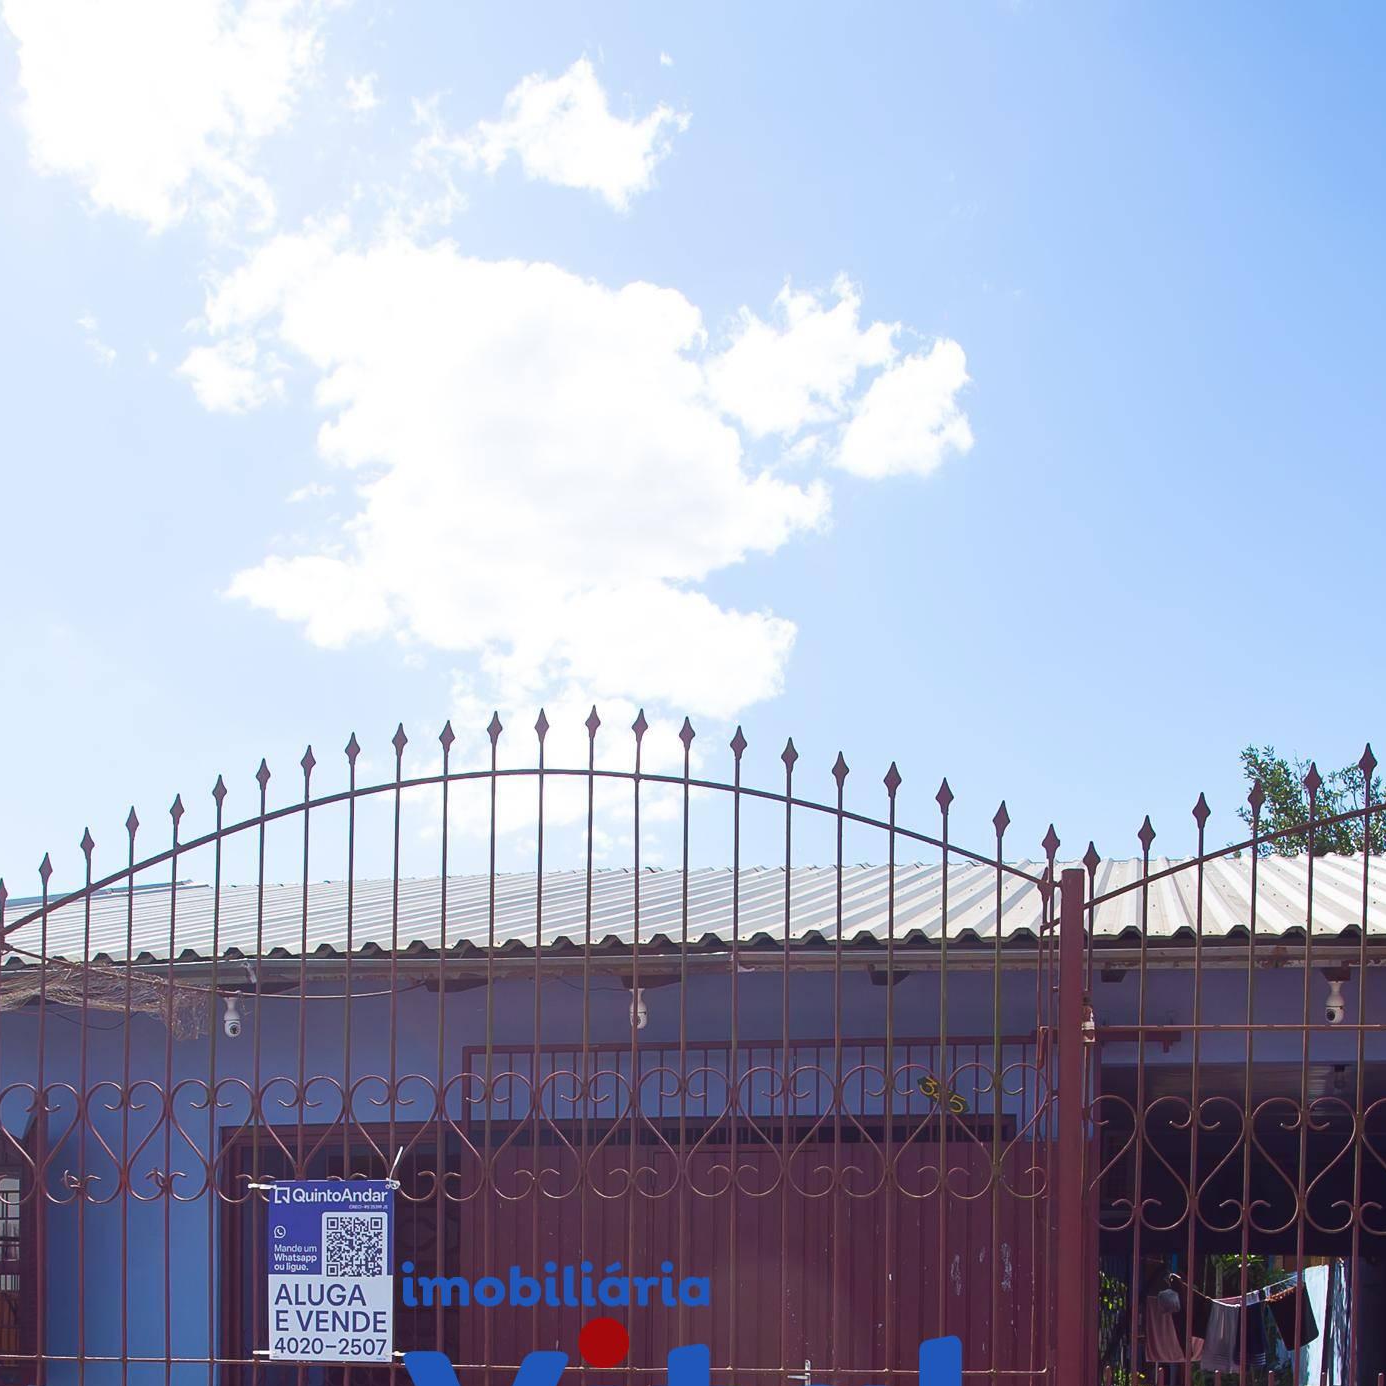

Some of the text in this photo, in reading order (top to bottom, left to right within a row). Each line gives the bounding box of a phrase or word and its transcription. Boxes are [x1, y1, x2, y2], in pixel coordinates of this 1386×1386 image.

[293, 1188, 387, 1203] QuintoAndar
[274, 1244, 302, 1253] Mande
[274, 1253, 317, 1263] Whatsapp
[286, 1262, 309, 1273] ligue.
[274, 1284, 367, 1306] ALUGA
[276, 1310, 387, 1333] E VENDE
[274, 1338, 387, 1356] 4020-2507
